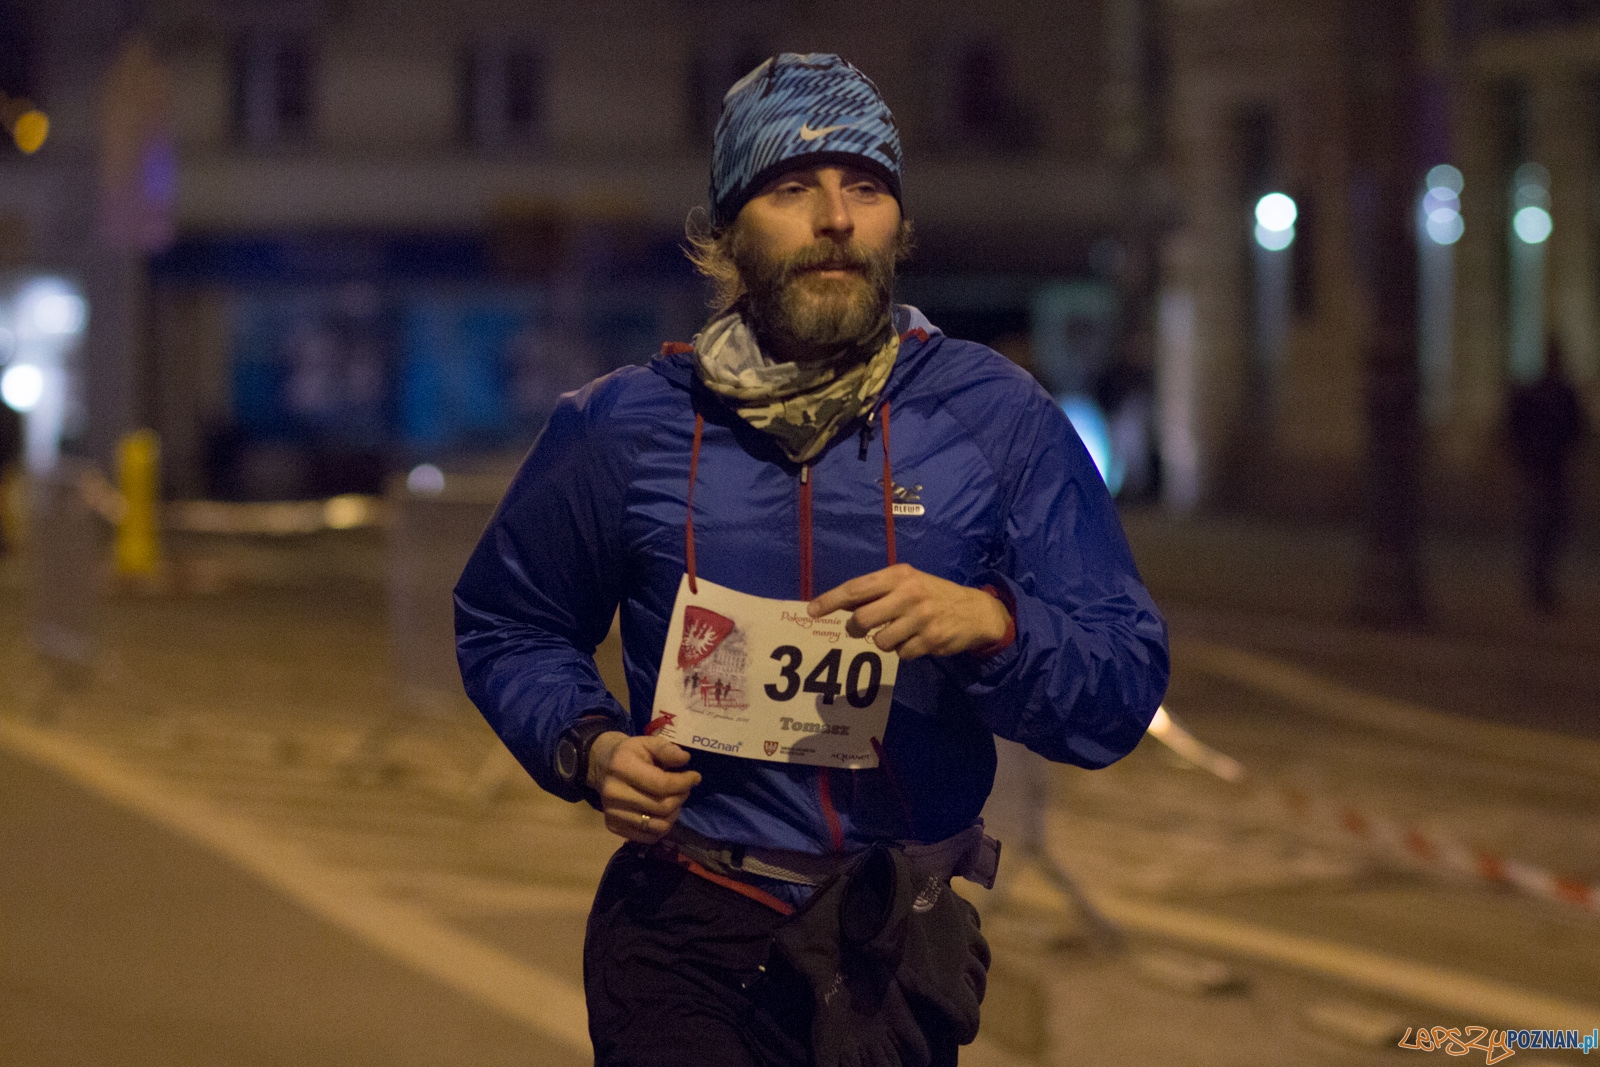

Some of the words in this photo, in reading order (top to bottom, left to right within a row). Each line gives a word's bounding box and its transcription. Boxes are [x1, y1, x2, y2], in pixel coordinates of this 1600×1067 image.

[812, 629, 841, 643] mamy
[763, 644, 882, 709] 340
[779, 717, 850, 736] Tomasz
